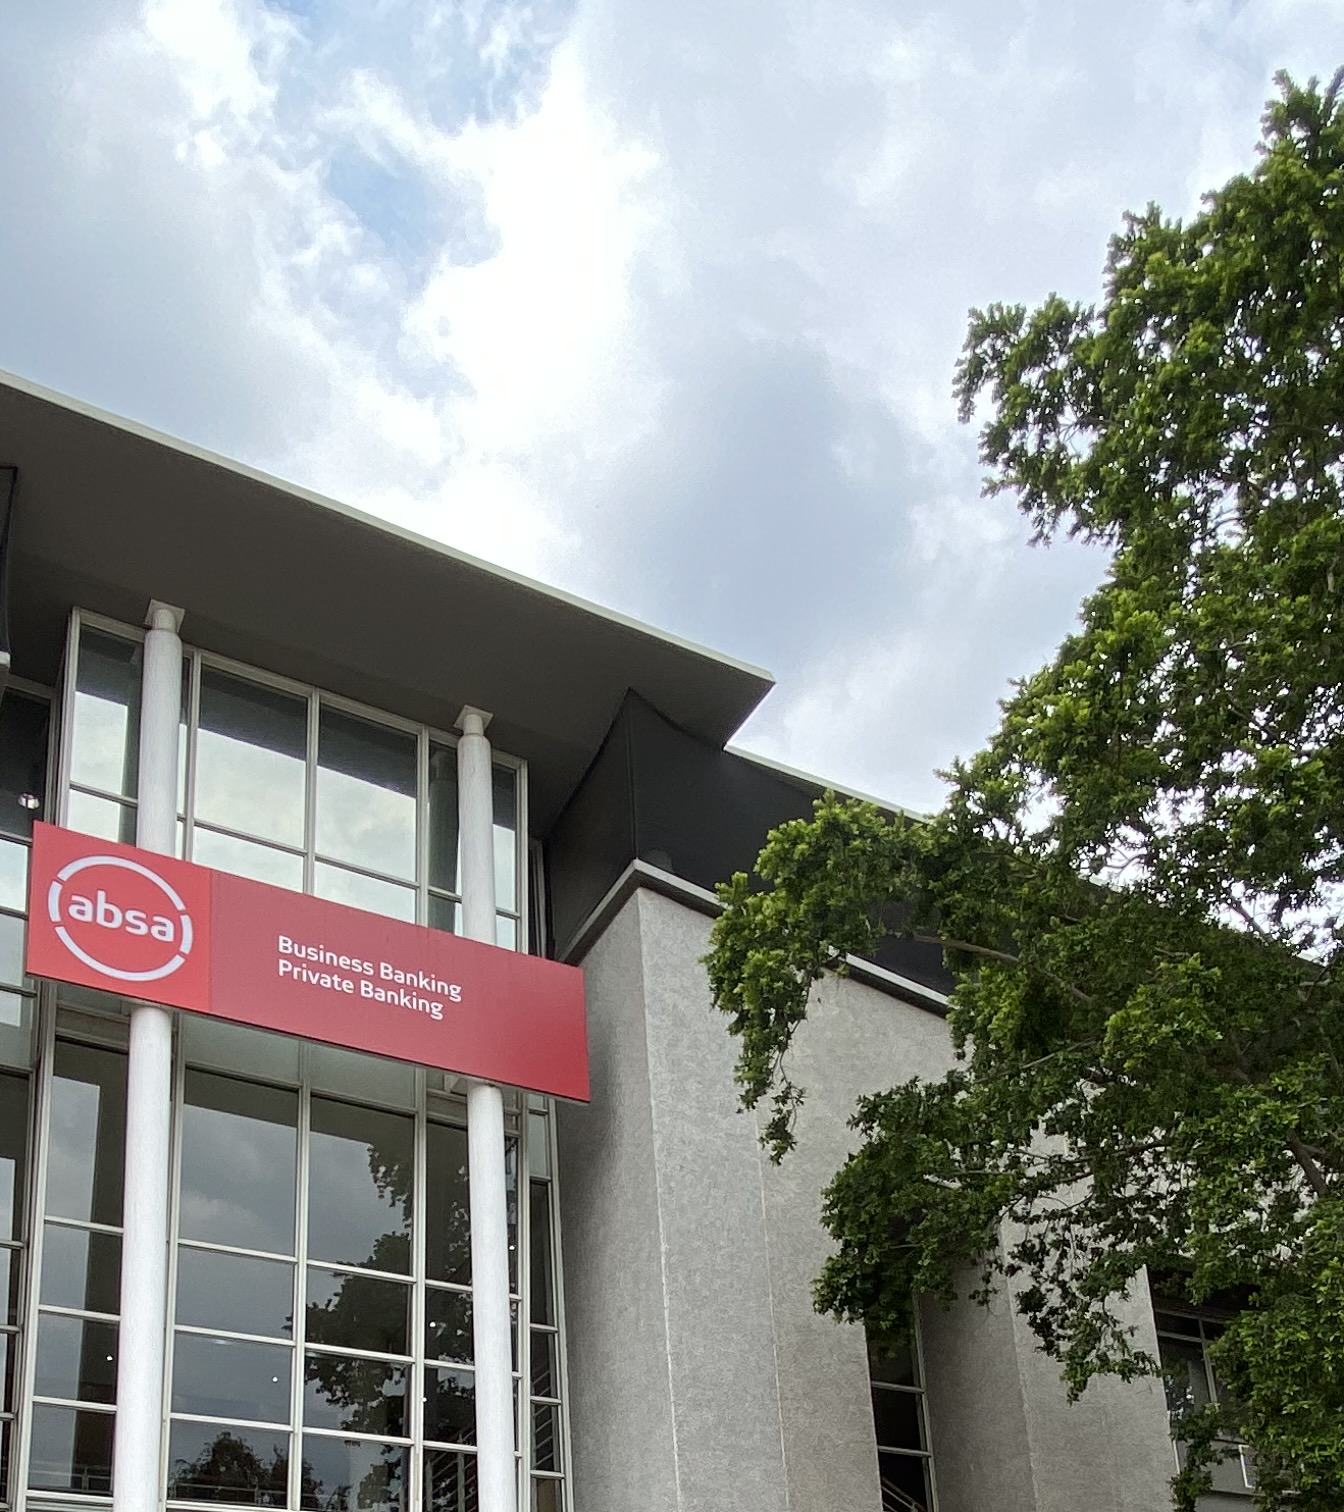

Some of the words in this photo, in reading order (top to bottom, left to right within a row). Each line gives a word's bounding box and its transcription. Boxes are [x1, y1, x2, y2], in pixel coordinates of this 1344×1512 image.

[68, 889, 175, 943] absa
[278, 935, 375, 976] Business
[379, 962, 462, 1002] Banking
[278, 959, 355, 994] Private
[360, 980, 444, 1020] Banking
